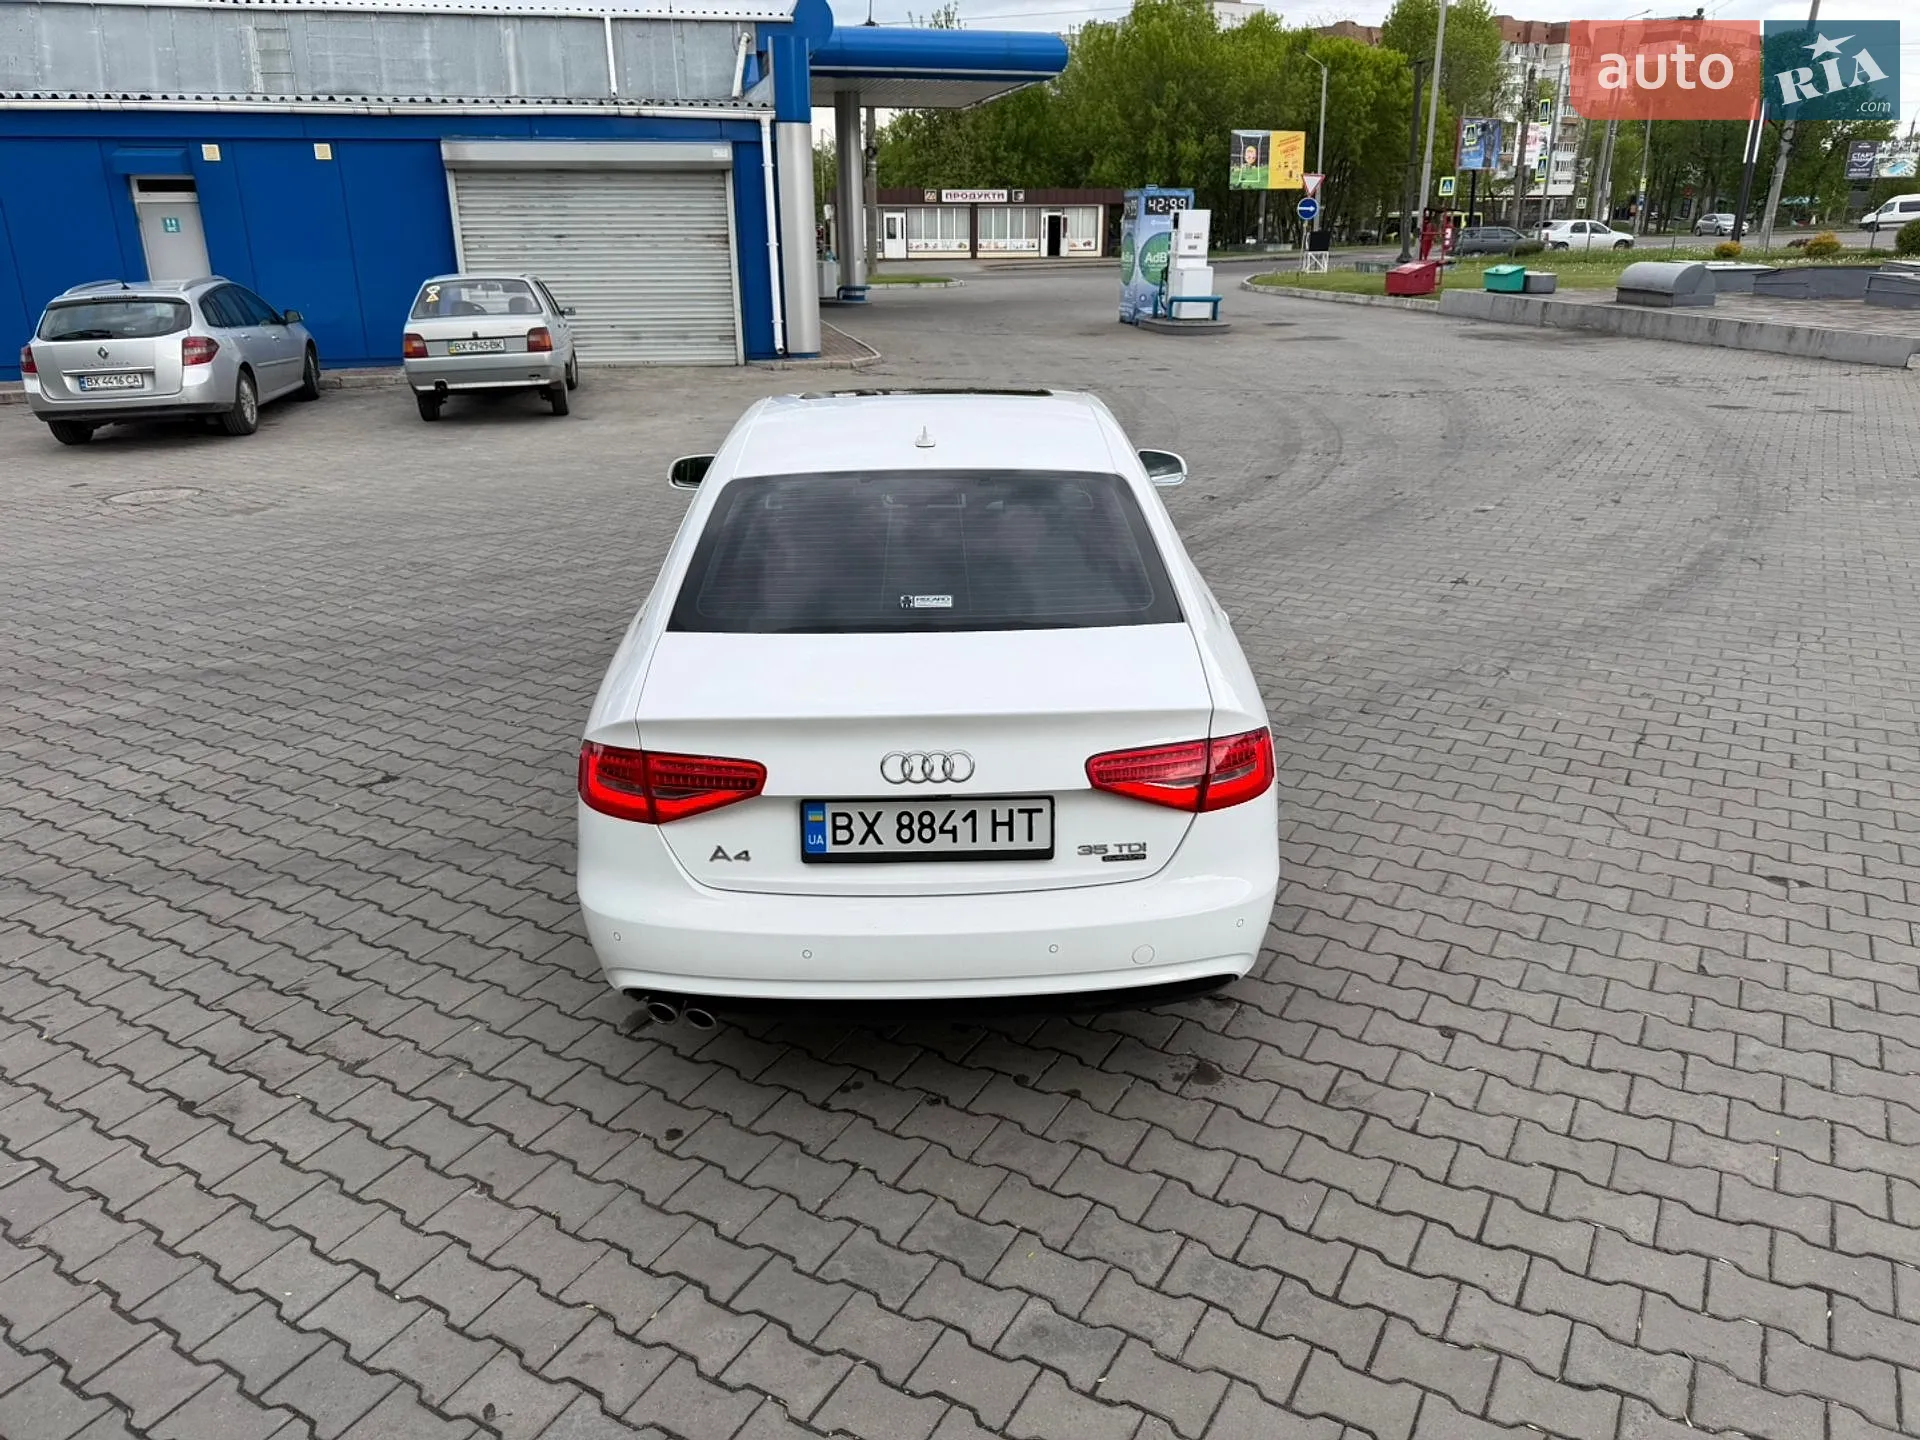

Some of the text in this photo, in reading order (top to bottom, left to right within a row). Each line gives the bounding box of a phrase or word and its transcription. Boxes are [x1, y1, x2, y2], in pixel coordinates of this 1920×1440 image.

[945, 191, 1005, 200] ПРОДУКТИ
[1148, 198, 1186, 212] 42:99
[1144, 251, 1168, 263] AdB
[102, 376, 125, 385] 4416
[830, 808, 1044, 846] BX 8841 HT
[807, 834, 824, 846] UA
[709, 845, 751, 862] A4
[1077, 842, 1147, 856] 35 TDI
